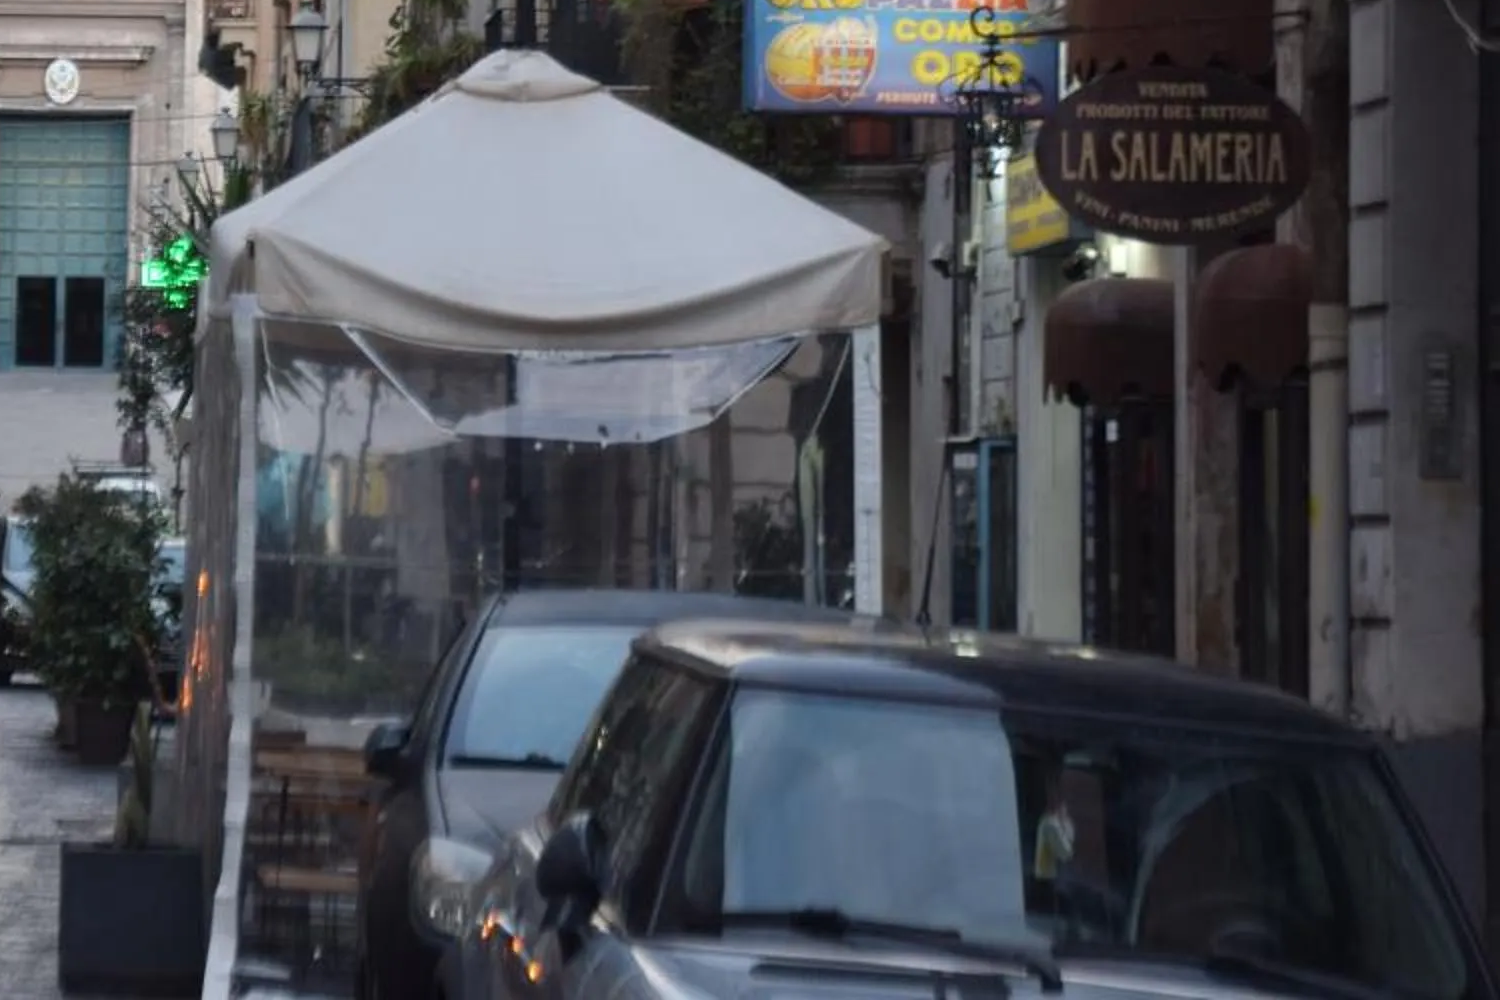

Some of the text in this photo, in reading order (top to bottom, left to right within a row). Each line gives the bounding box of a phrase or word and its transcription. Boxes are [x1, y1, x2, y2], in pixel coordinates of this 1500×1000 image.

[912, 49, 1024, 87] ORO
[1137, 81, 1208, 97] VENDITA
[1076, 104, 1158, 119] PRODOTTI
[1060, 131, 1286, 183] LA SALAMERIA
[1118, 211, 1180, 232] PANINI
